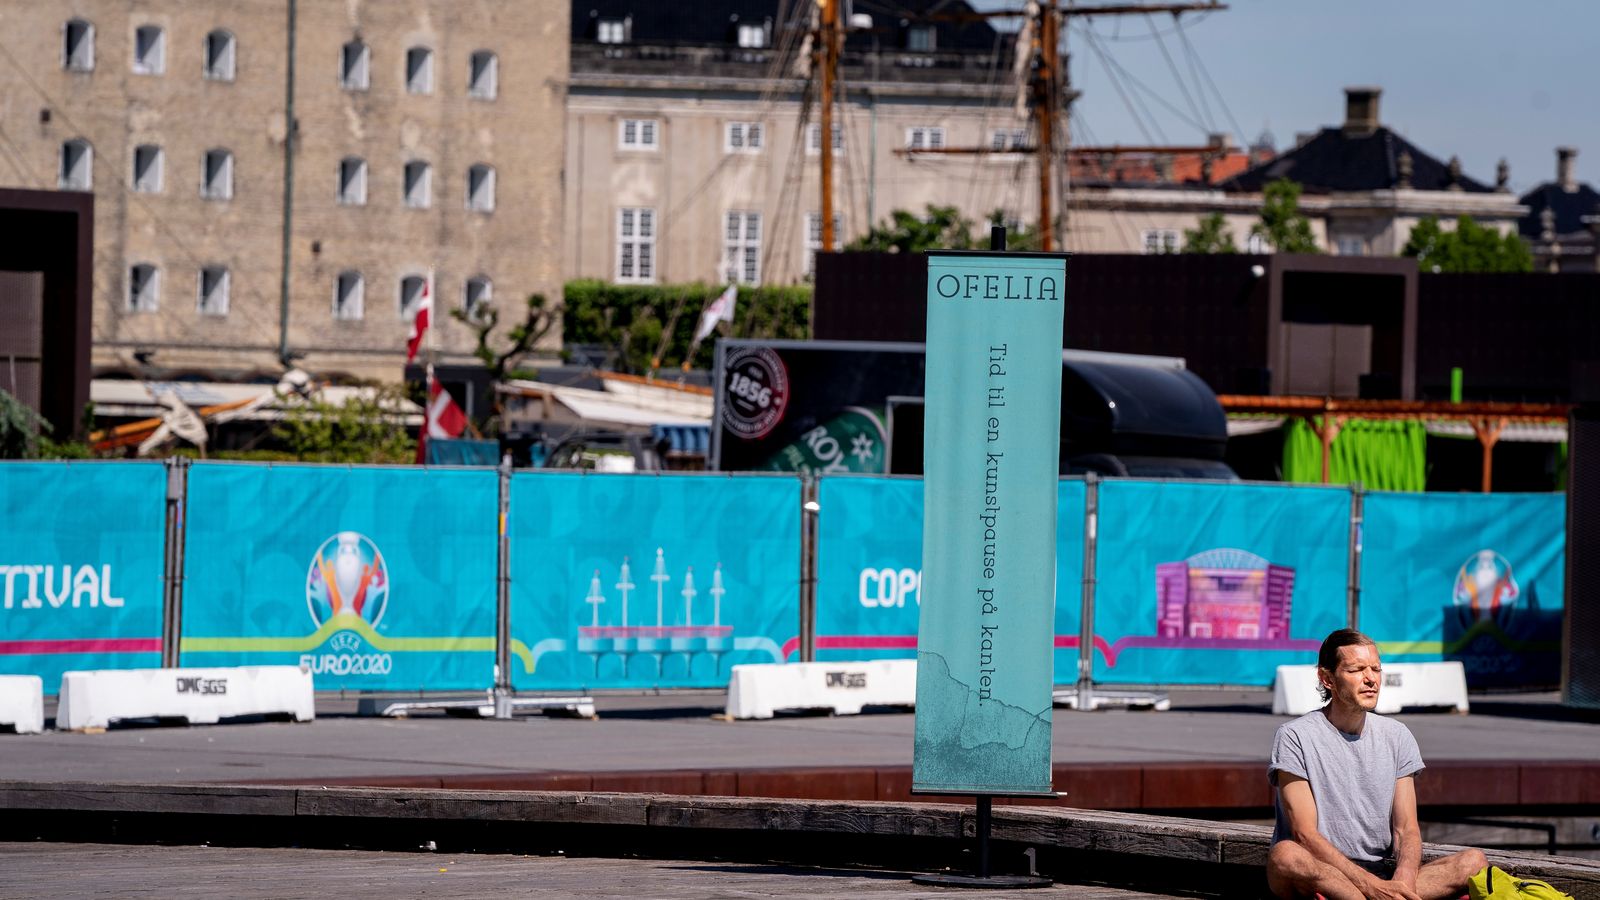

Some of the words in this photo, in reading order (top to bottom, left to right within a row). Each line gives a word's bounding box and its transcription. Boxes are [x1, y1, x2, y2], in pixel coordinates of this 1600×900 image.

[937, 274, 1058, 301] OFELIA
[989, 344, 1007, 377] Tid
[728, 372, 772, 408] 1856
[988, 387, 1006, 409] til
[987, 417, 1000, 443] en
[979, 452, 1004, 579] kunstpause
[0, 564, 125, 609] TIVAL
[977, 588, 998, 616] på
[979, 625, 999, 707] kanten.
